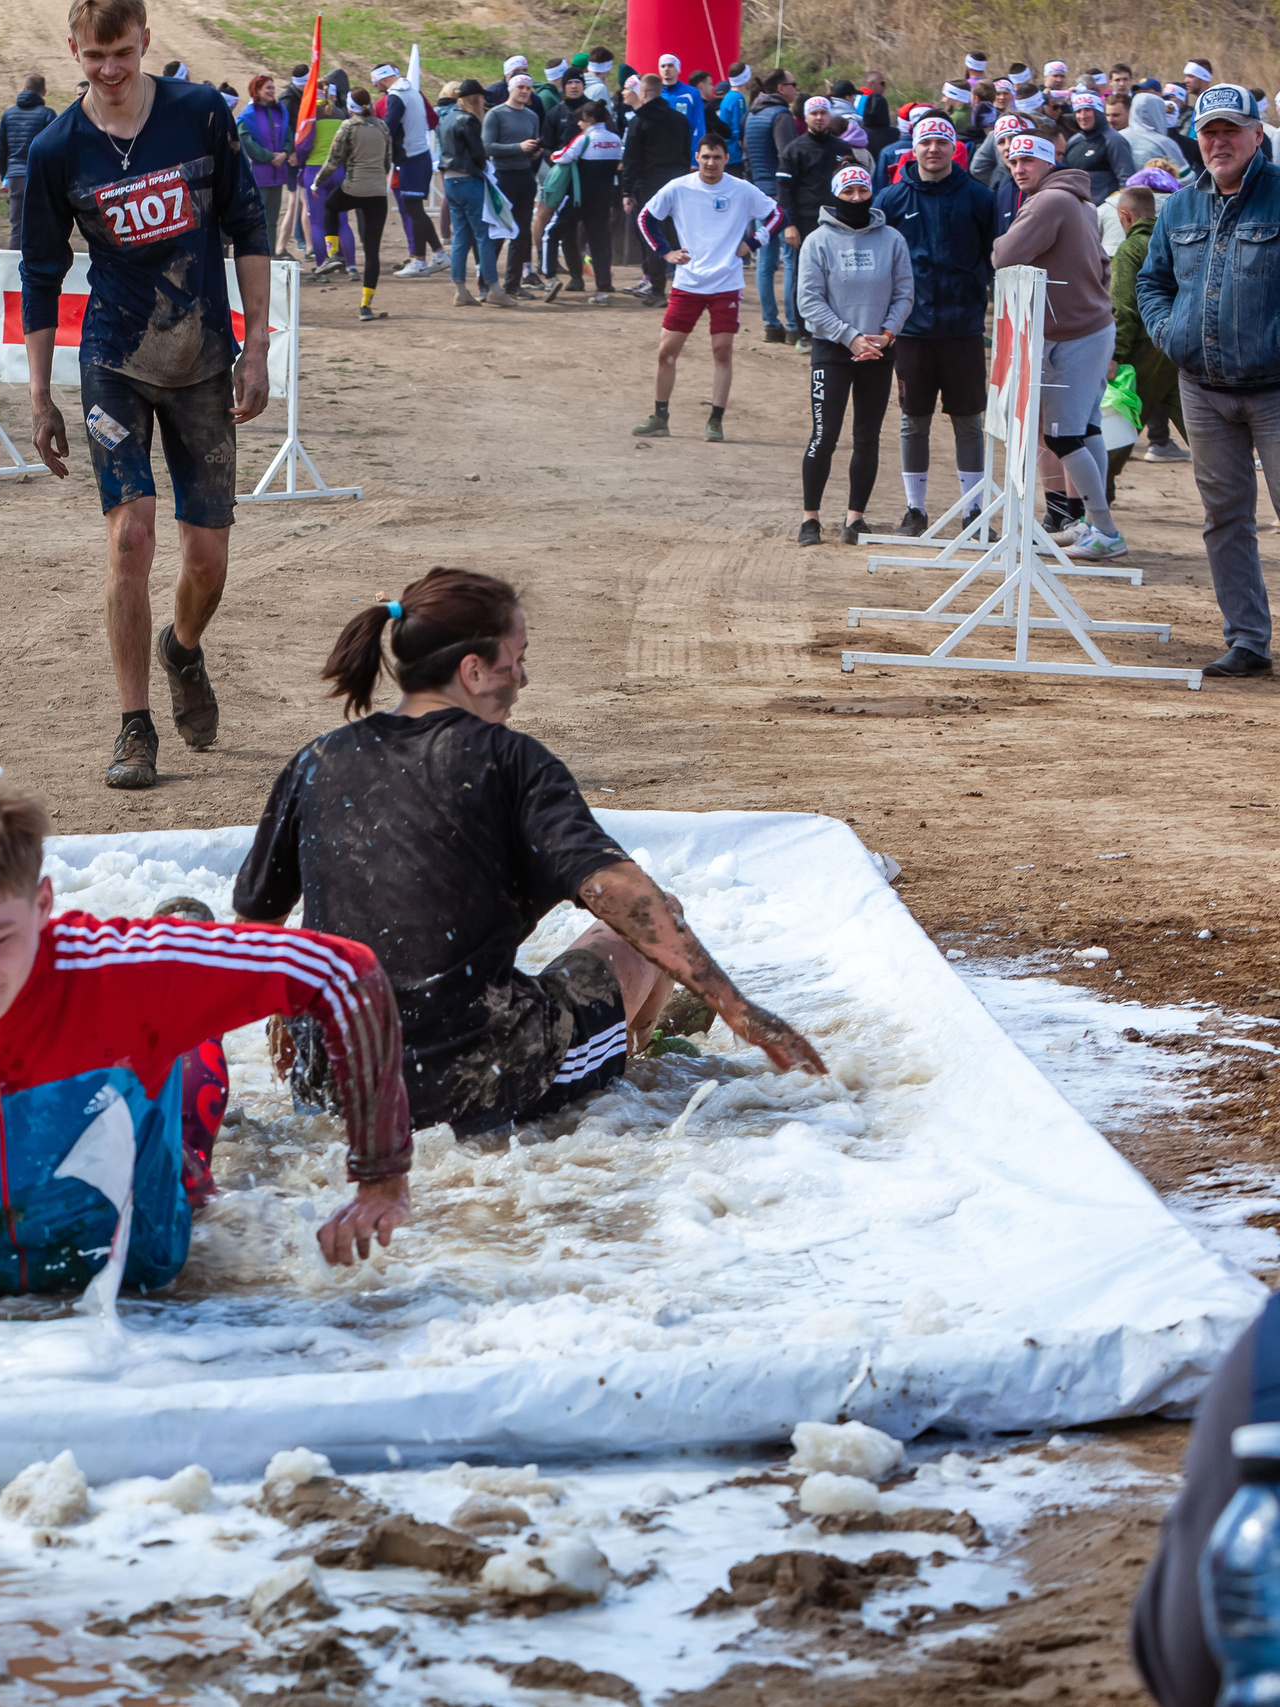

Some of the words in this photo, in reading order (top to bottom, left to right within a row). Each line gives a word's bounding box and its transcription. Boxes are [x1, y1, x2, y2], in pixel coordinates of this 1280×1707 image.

[1011, 138, 1034, 151] 09
[100, 179, 147, 200] СИБИРСКИЙ
[149, 170, 181, 186] ПРЕДЕЛ
[105, 187, 184, 234] 2107
[813, 369, 825, 400] EA7
